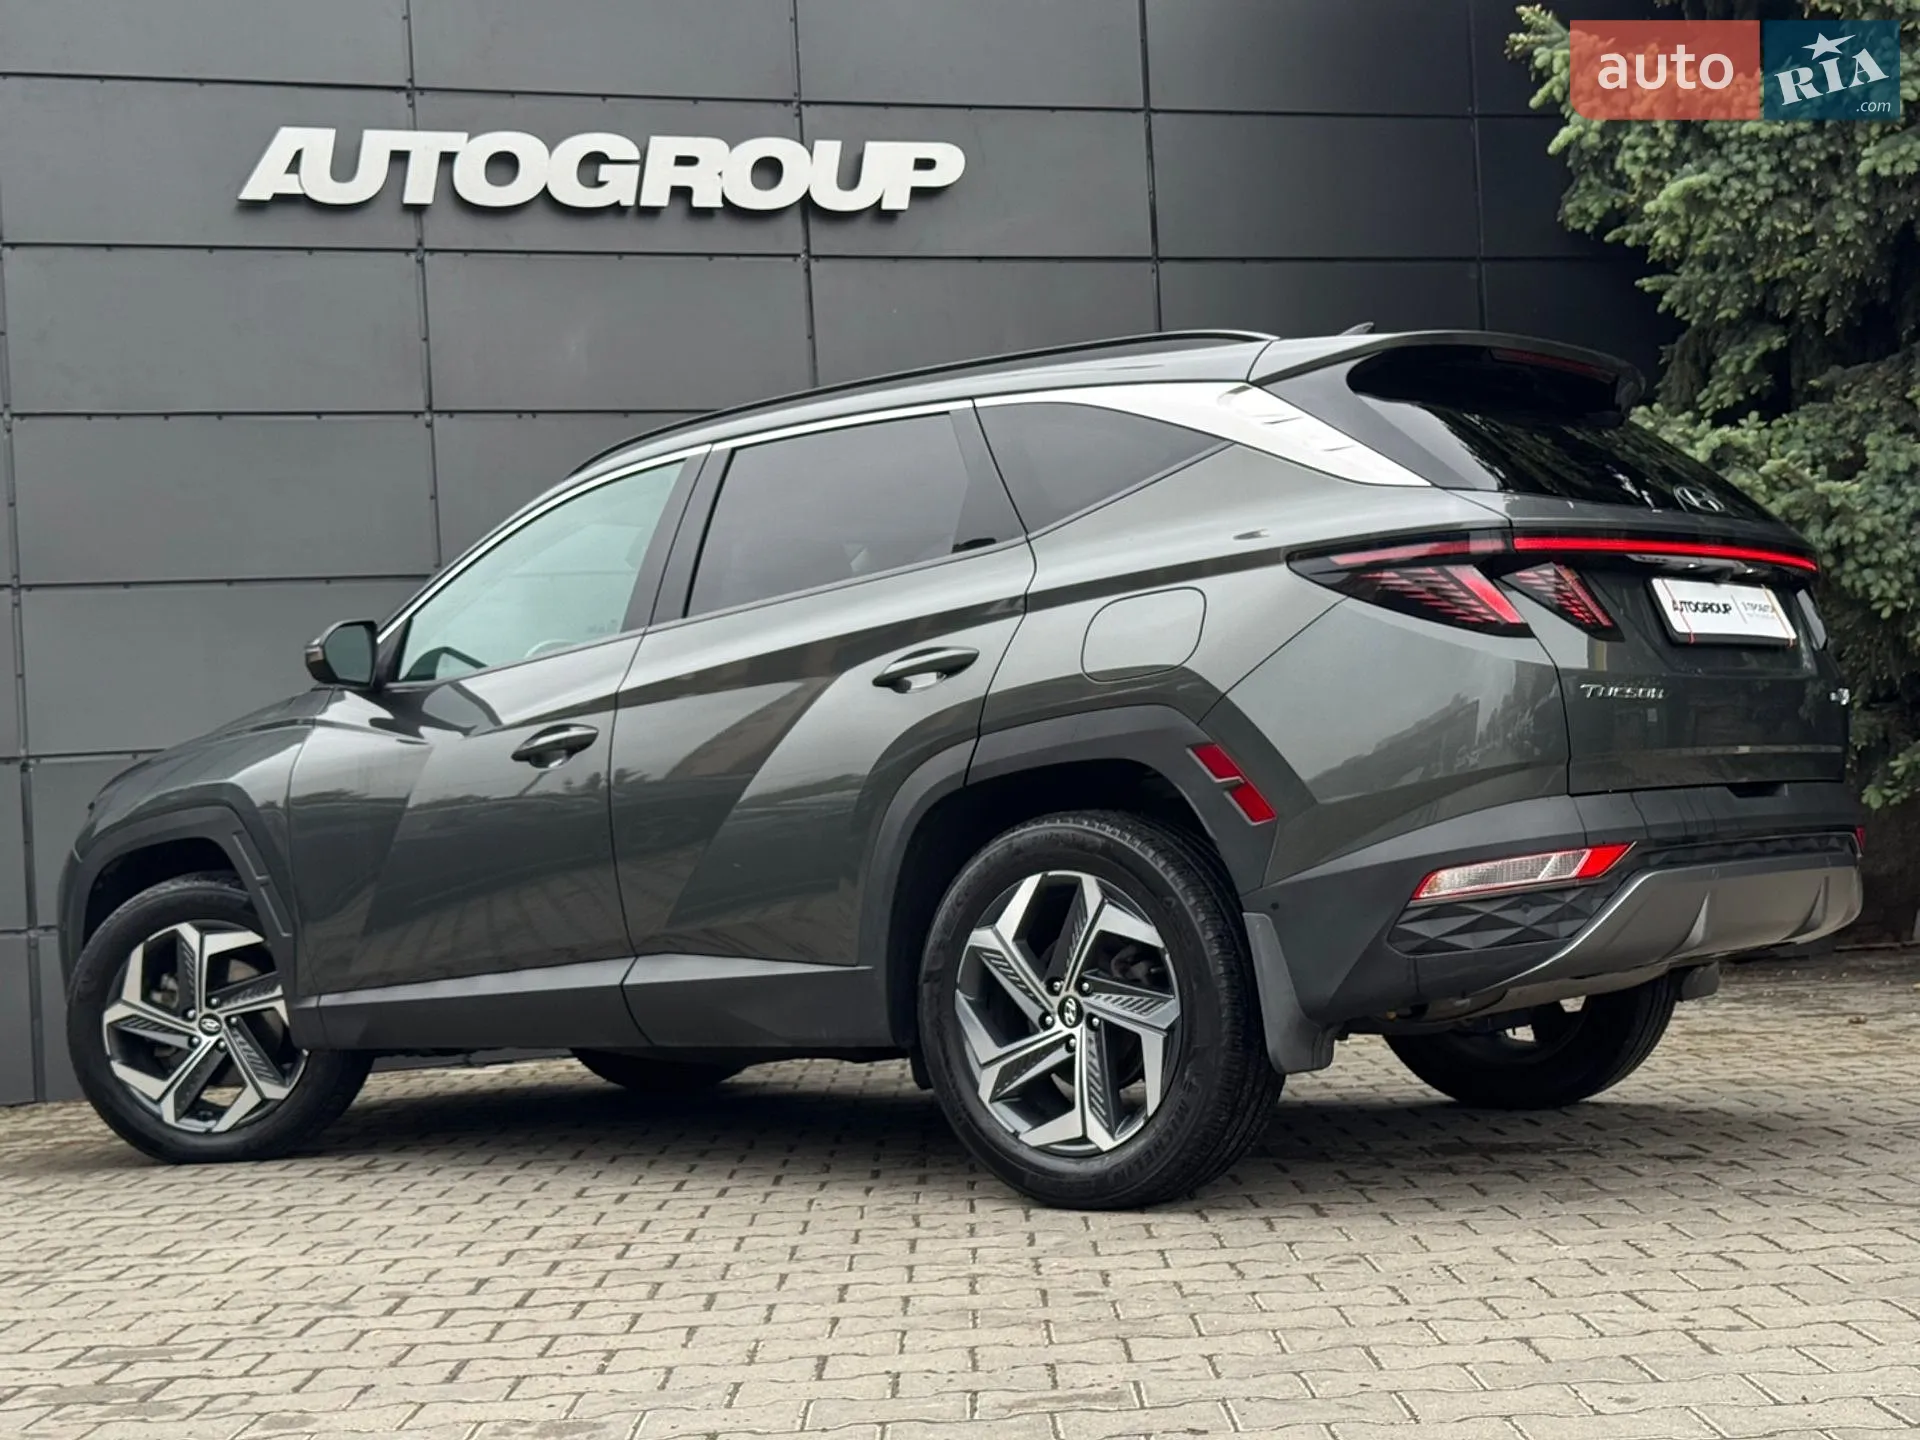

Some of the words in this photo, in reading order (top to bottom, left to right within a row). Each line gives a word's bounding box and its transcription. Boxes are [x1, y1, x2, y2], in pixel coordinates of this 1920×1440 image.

[238, 126, 966, 211] AUTOGROUP
[1672, 599, 1732, 614] AUTOGROUP
[1580, 684, 1664, 698] TUCSON
